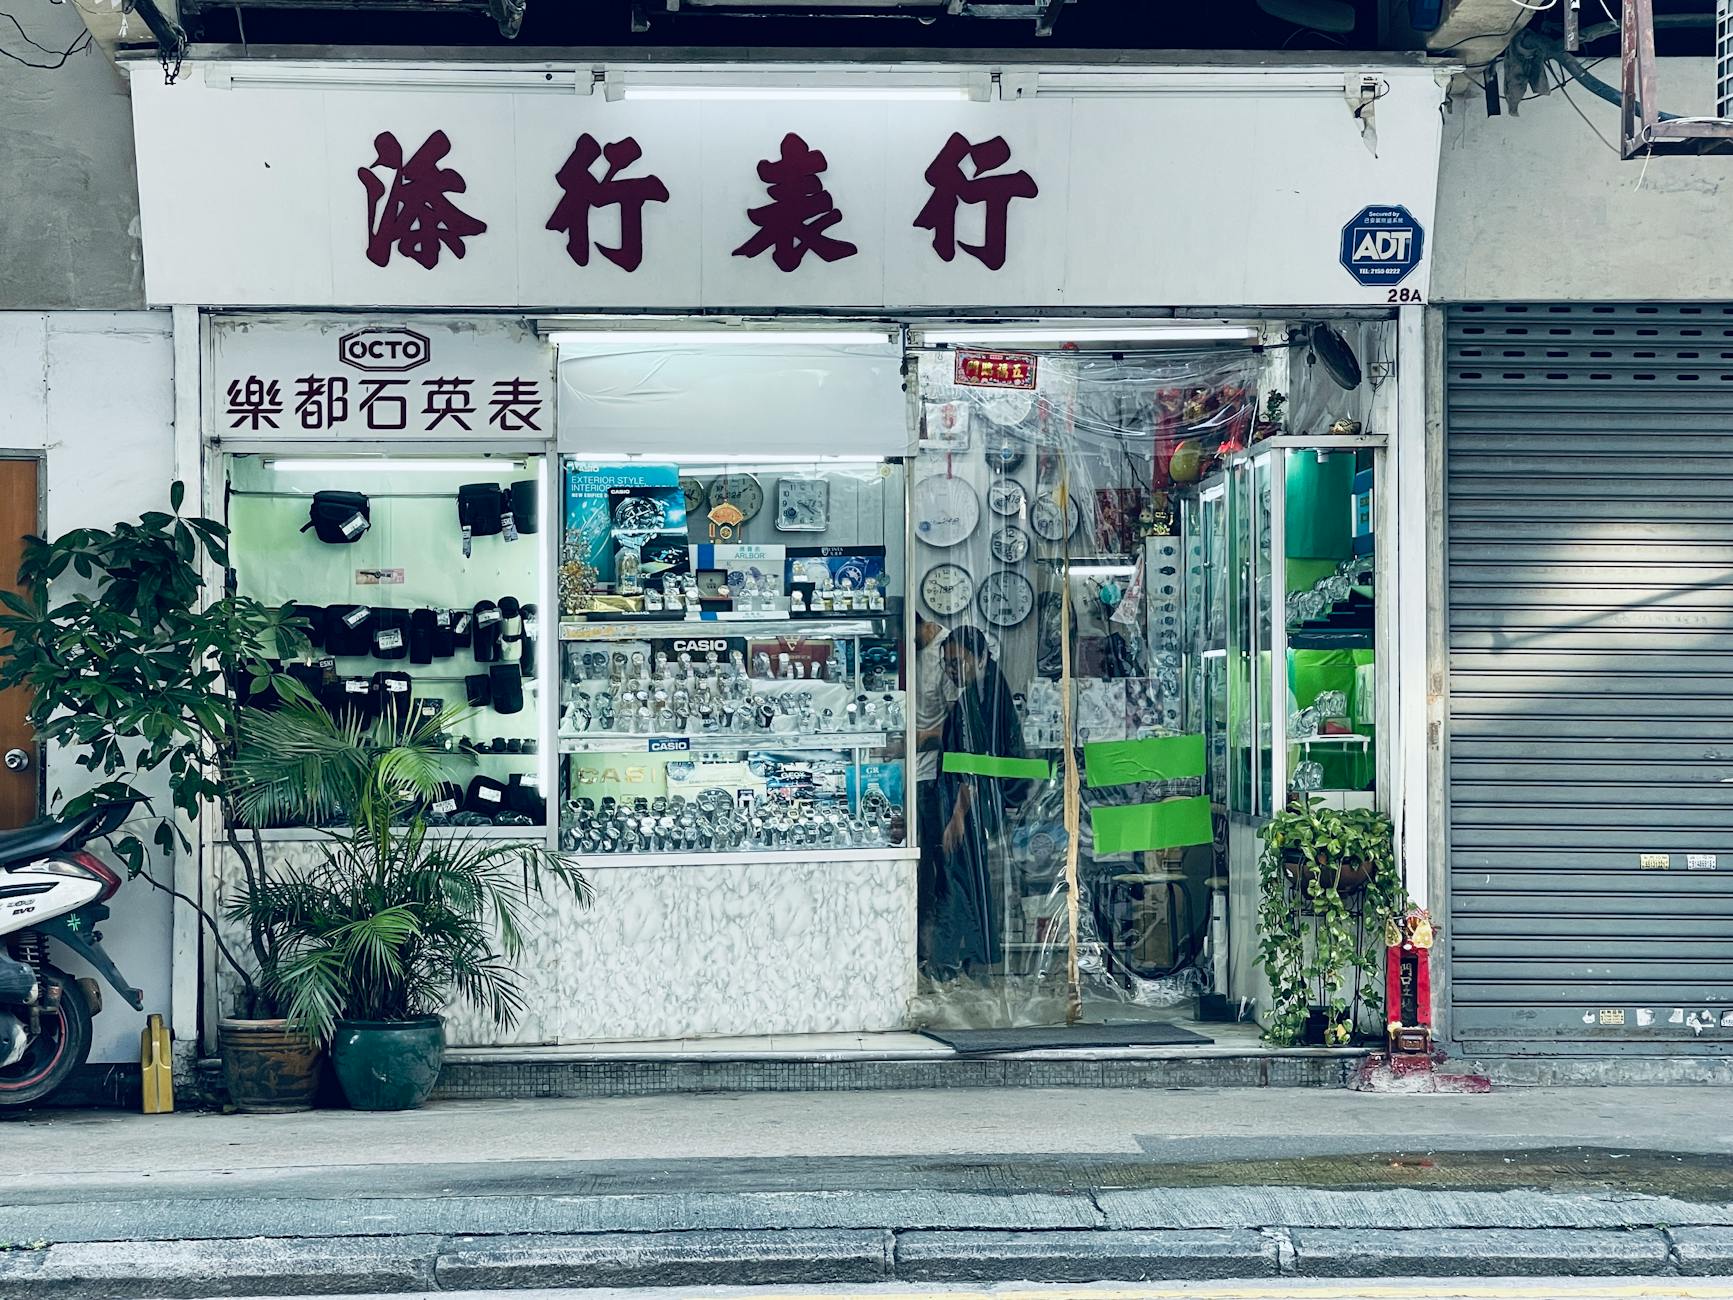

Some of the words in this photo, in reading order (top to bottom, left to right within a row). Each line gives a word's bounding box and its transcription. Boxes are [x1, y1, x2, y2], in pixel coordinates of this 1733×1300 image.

[1353, 231, 1412, 260] ADT
[1387, 288, 1422, 302] 28A
[348, 340, 421, 359] OCTO
[226, 373, 543, 431] 樂都石英表
[571, 476, 615, 484] EXTERIOR
[673, 640, 728, 652] CASIO
[651, 742, 687, 751] CASIO
[578, 767, 656, 784] CASI
[12, 906, 35, 915] EVO
